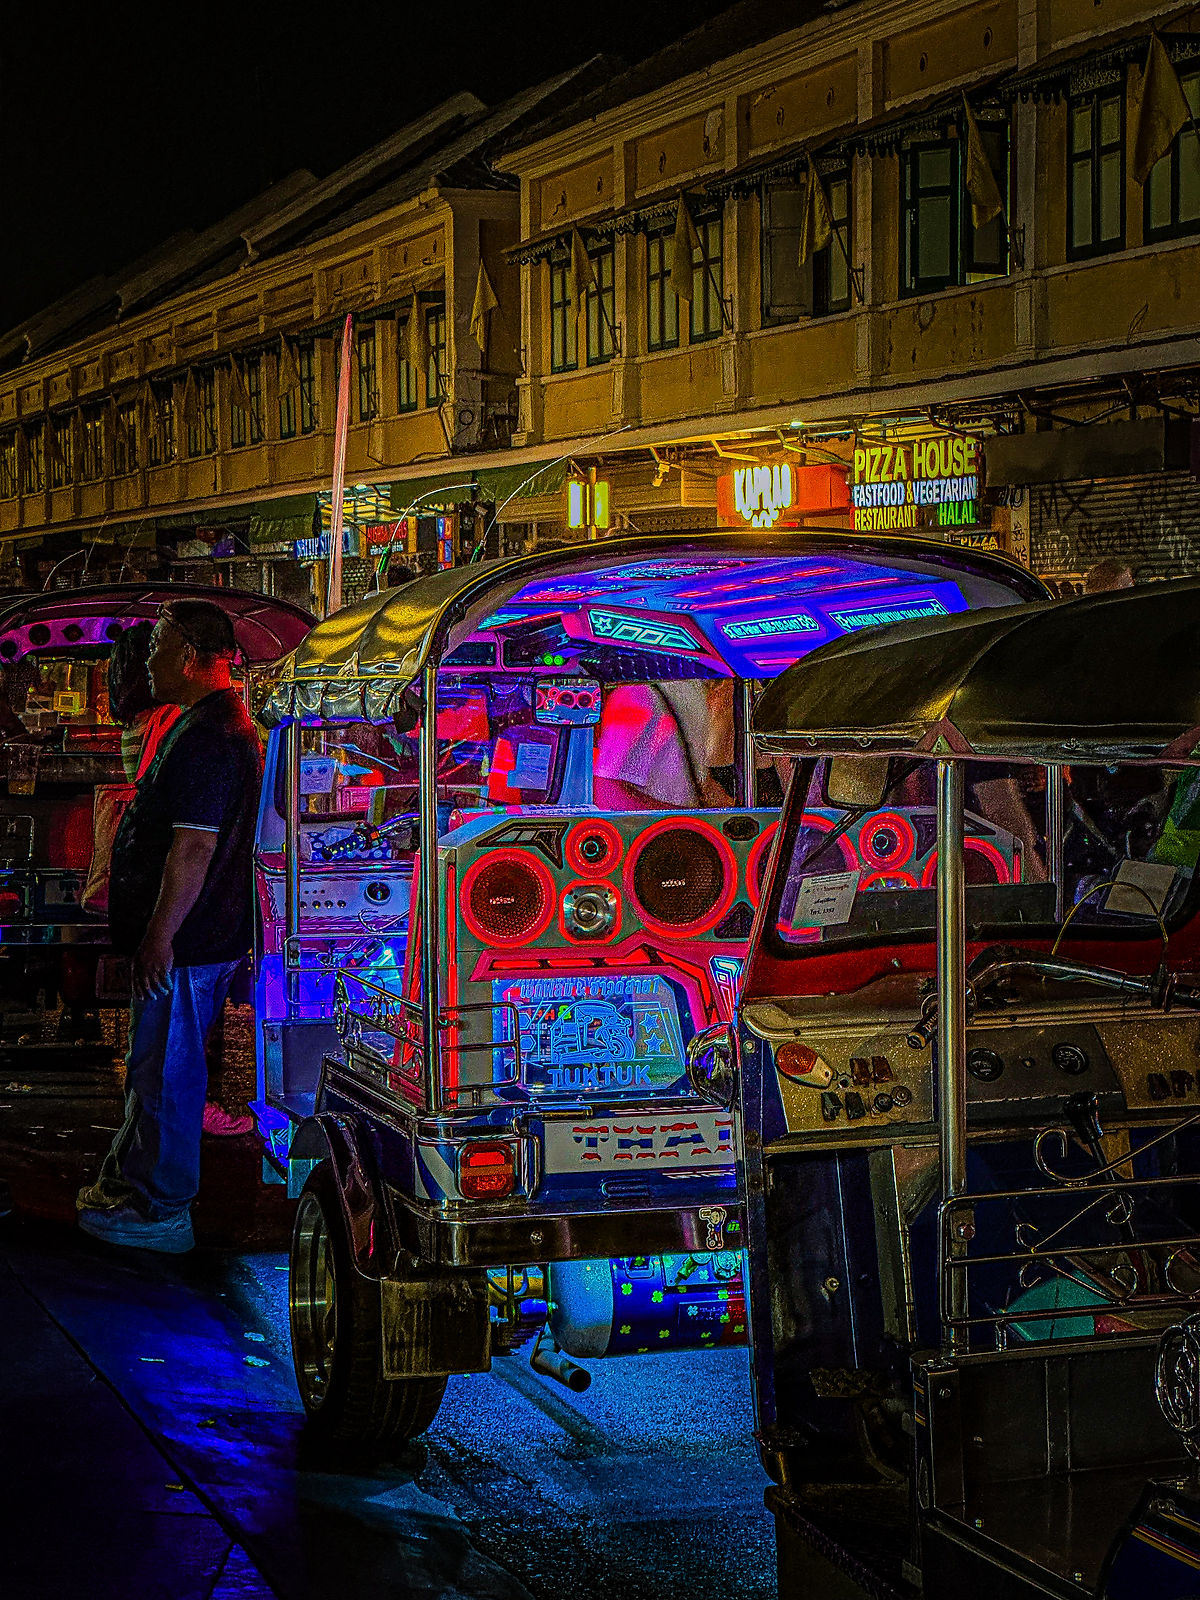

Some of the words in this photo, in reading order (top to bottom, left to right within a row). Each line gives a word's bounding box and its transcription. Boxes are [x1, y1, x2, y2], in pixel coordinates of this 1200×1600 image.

[854, 447, 907, 483] PIZZA
[913, 436, 977, 478] HOUSE
[853, 481, 905, 507] FASTFOOD
[906, 480, 914, 503] &
[912, 476, 977, 504] VEGETARIAN
[854, 505, 917, 530] RESTAURANT
[937, 501, 976, 525] HALAL
[547, 1064, 652, 1089] TUKTUK
